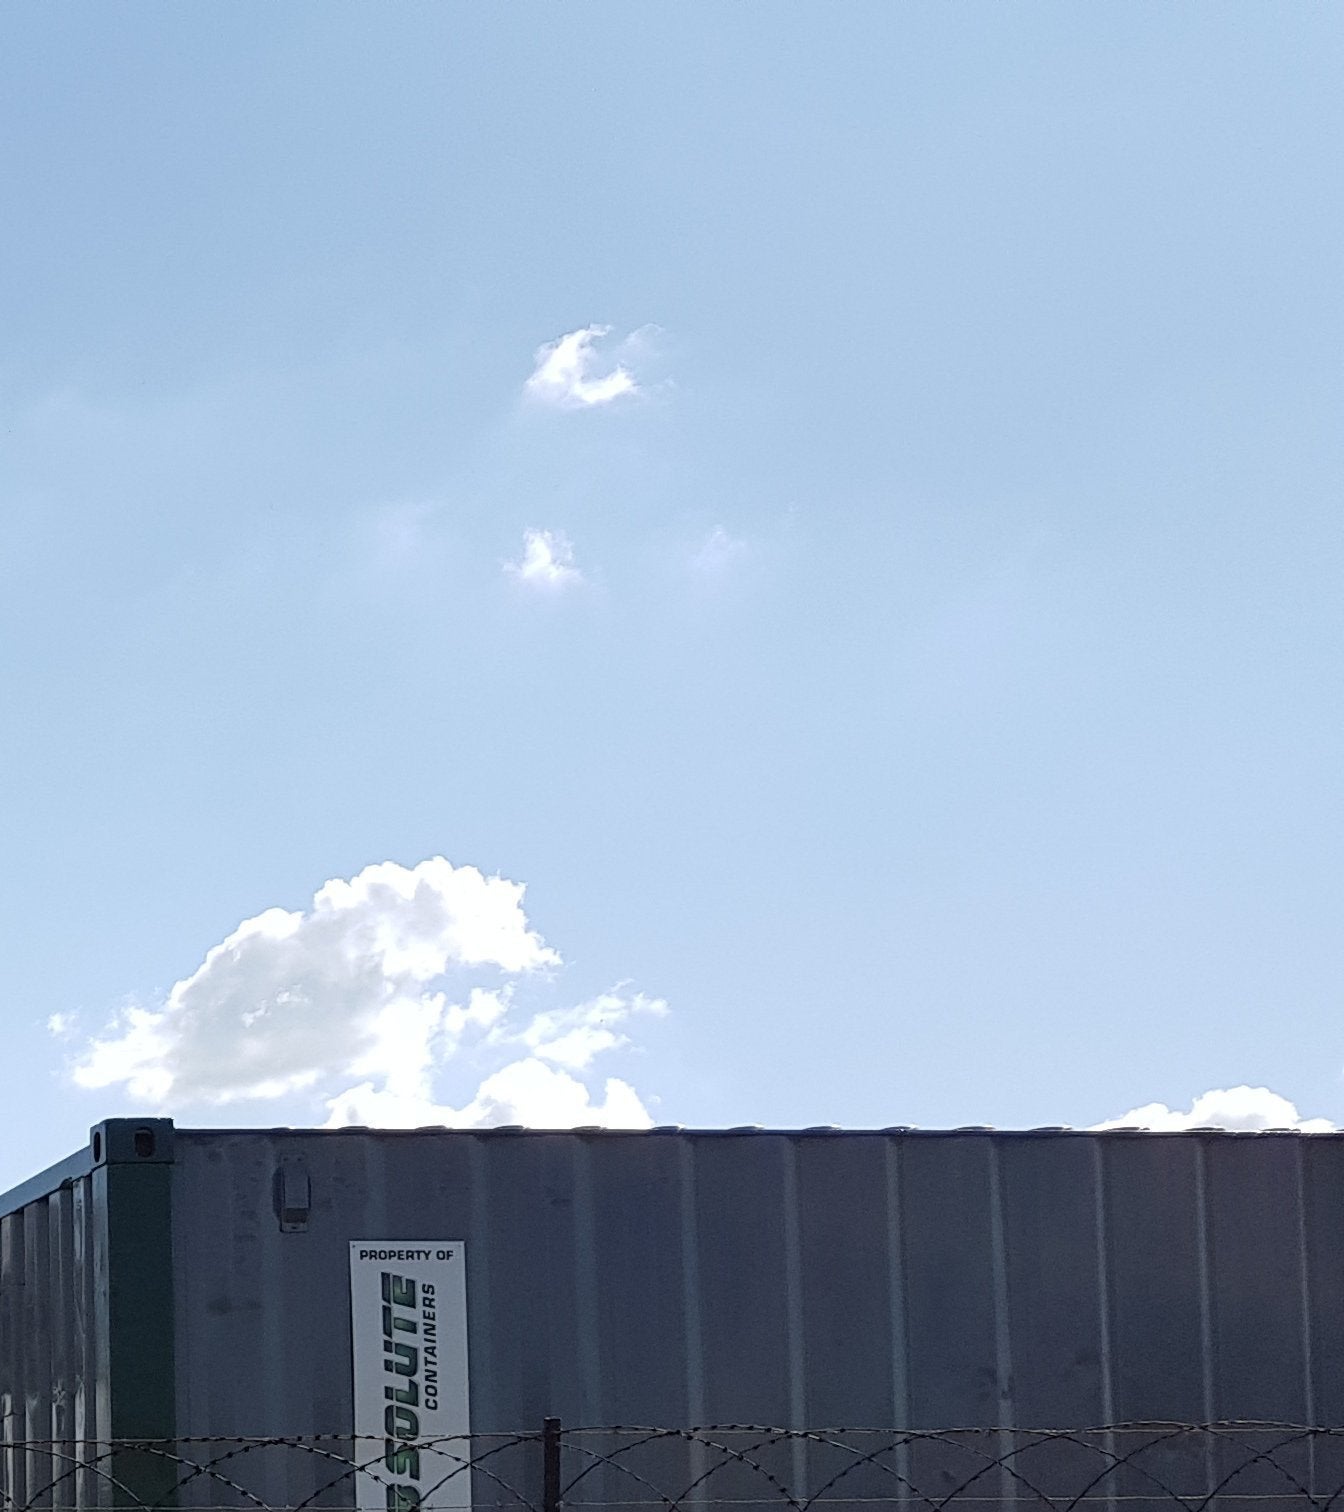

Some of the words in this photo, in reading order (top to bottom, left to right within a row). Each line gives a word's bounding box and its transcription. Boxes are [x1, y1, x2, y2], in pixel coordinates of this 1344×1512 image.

[360, 1250, 431, 1260] PROPERTY
[436, 1250, 453, 1260] OF
[422, 1283, 438, 1410] CONTAINERS
